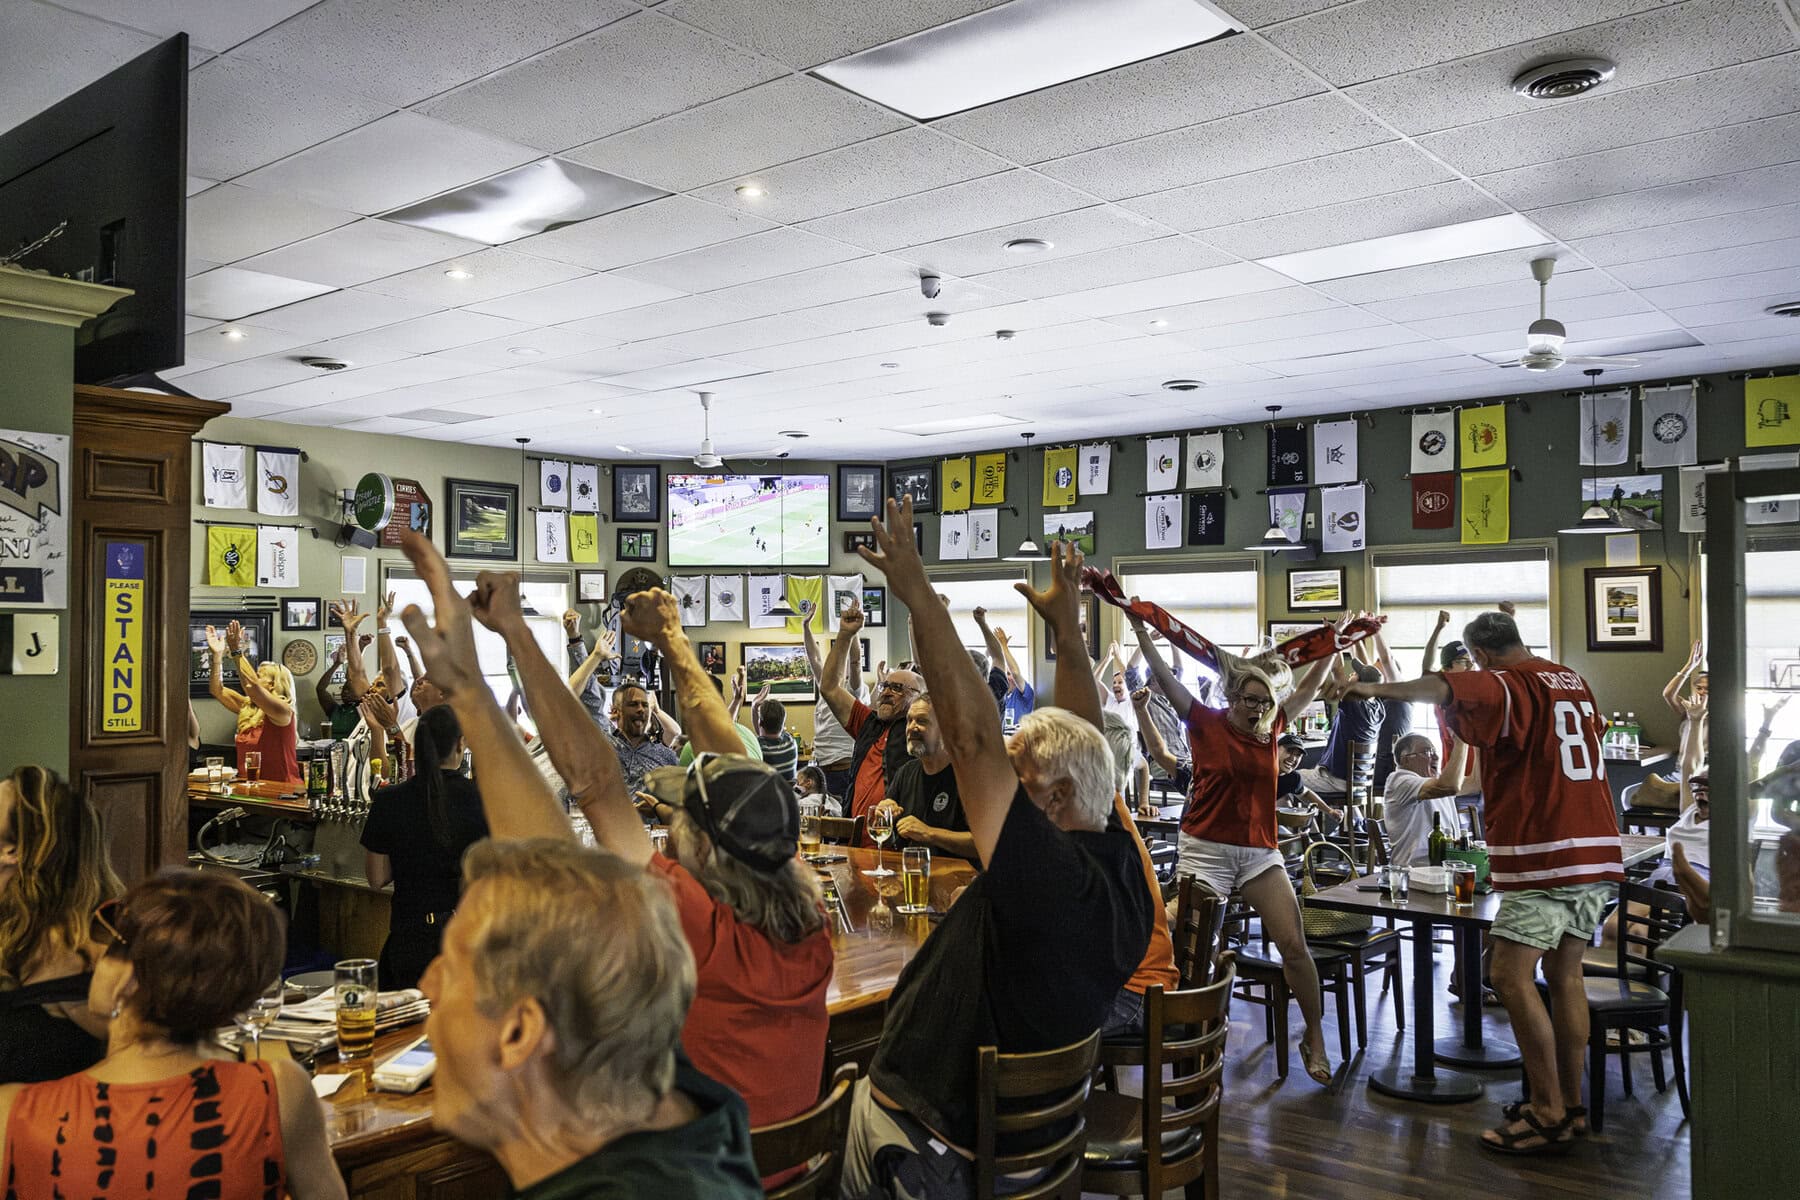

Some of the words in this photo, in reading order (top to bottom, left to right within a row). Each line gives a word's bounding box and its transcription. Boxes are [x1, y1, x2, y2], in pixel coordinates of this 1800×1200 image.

[984, 465, 995, 498] OPEN
[1294, 470, 1303, 481] 18
[109, 582, 140, 590] PLEASE
[112, 593, 134, 714] STAND
[107, 718, 137, 727] STILL
[1553, 700, 1605, 782] 87
